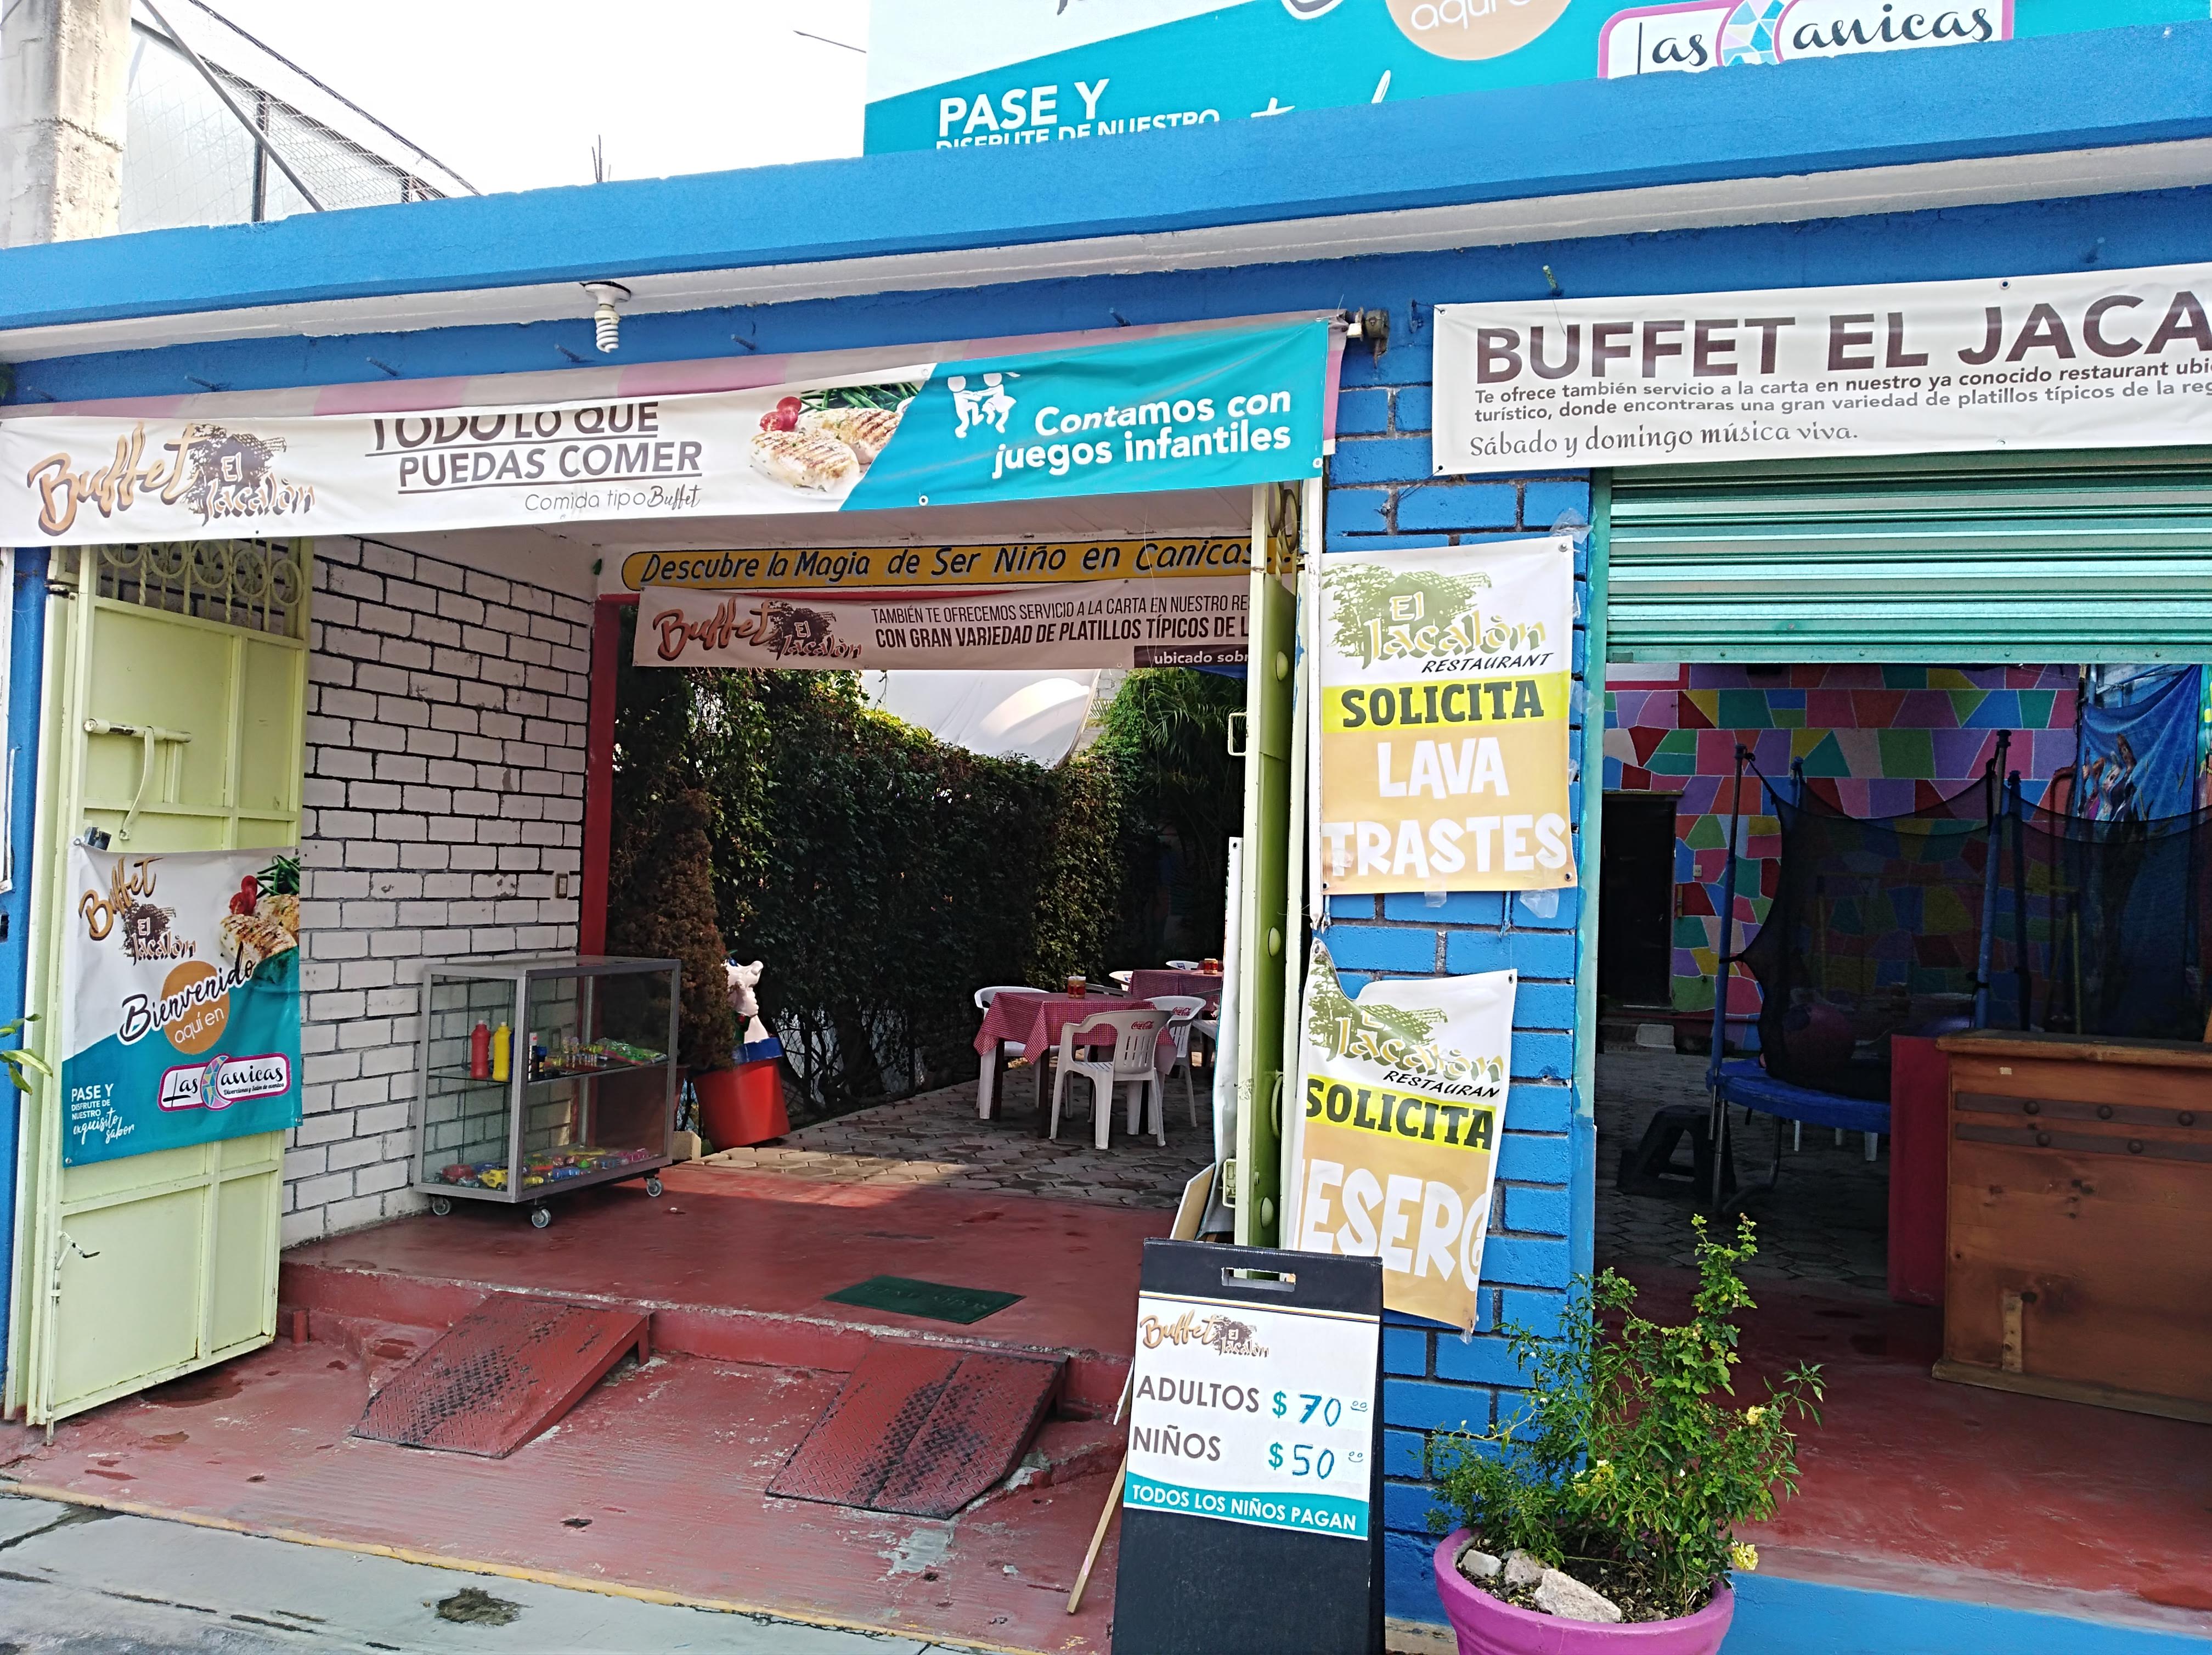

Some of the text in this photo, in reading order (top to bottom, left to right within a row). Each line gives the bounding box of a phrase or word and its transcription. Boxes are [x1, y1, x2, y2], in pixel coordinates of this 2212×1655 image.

[1411, 0, 1497, 30] aqu
[939, 78, 1110, 137] PASE Y
[1476, 316, 1796, 384] BUFFET
[1827, 311, 1929, 371] EL
[1475, 357, 2212, 404] Te ofrece también servicio a la carta en nuestro ya conocido restaurant ubi
[574, 401, 659, 434] QUE
[1035, 390, 1291, 437] Contamos con
[1475, 405, 1553, 422] turístico,
[1559, 398, 1617, 416] donde
[1623, 398, 1734, 412] encontraras
[1741, 400, 1775, 412] una
[1781, 399, 1825, 415] gran
[1832, 392, 1918, 409] variedad
[1926, 391, 1951, 407] de
[1958, 387, 2038, 408] platillos
[2044, 386, 2115, 404] típicos
[2121, 381, 2149, 397] de
[2157, 380, 2175, 395] la
[991, 420, 1291, 479] juegos infantiles
[1470, 428, 1558, 457] Sábado
[1564, 436, 1578, 458] y
[1585, 424, 1693, 453] domingo
[1701, 420, 1792, 444] música
[27, 421, 207, 536] Buffet
[221, 452, 242, 483] El
[399, 441, 702, 487] PUEDAS COMER
[525, 483, 703, 511] Comida tipo Buffet
[641, 552, 760, 582] Descubre
[767, 551, 788, 577] la
[794, 550, 870, 583] Magia
[887, 549, 921, 575] de
[931, 547, 980, 576] Ser
[993, 545, 1066, 573] Niño
[1082, 547, 1120, 571] en
[871, 594, 1250, 624] TAMBIÉN TE OFRECEMOS SERVICIO A LA CARTA EN NUESTRO RE
[1389, 590, 1425, 622] El
[652, 597, 783, 661] Buffet
[794, 620, 810, 639] El
[877, 628, 907, 648] CON
[910, 627, 952, 648] GRAN
[955, 624, 1034, 647] VARIEDAD
[1036, 623, 1057, 643] DE
[1058, 618, 1142, 641] PLATILLOS
[1146, 613, 1209, 639] TÍPICOS
[1214, 616, 1235, 637] DE
[1154, 650, 1212, 665] ubicado
[1421, 652, 1554, 674] RESTAURANT
[1341, 679, 1545, 728] SOLICITA
[1377, 736, 1510, 800] LAVA
[1322, 813, 1567, 879] TRASTES
[78, 855, 165, 942] Buffet
[137, 917, 151, 936] El
[119, 942, 257, 1043] Bienvenido
[174, 1006, 224, 1044] aquí en
[71, 1083, 114, 1102] PASE Y
[71, 1099, 111, 1112] DISFRUTE DE
[162, 1072, 198, 1107] Las
[72, 1109, 101, 1121] NUESTRO
[73, 1107, 119, 1145] exquisito
[105, 1116, 135, 1145] sabor
[1306, 1078, 1494, 1151] SOLICITA
[1140, 1309, 1229, 1349] Buffet
[1136, 1375, 1260, 1414] ADULTOS
[1132, 1425, 1221, 1462] NIÑOS
[1132, 1484, 1357, 1531] TODOS LOS NIÑOS PAGAN
